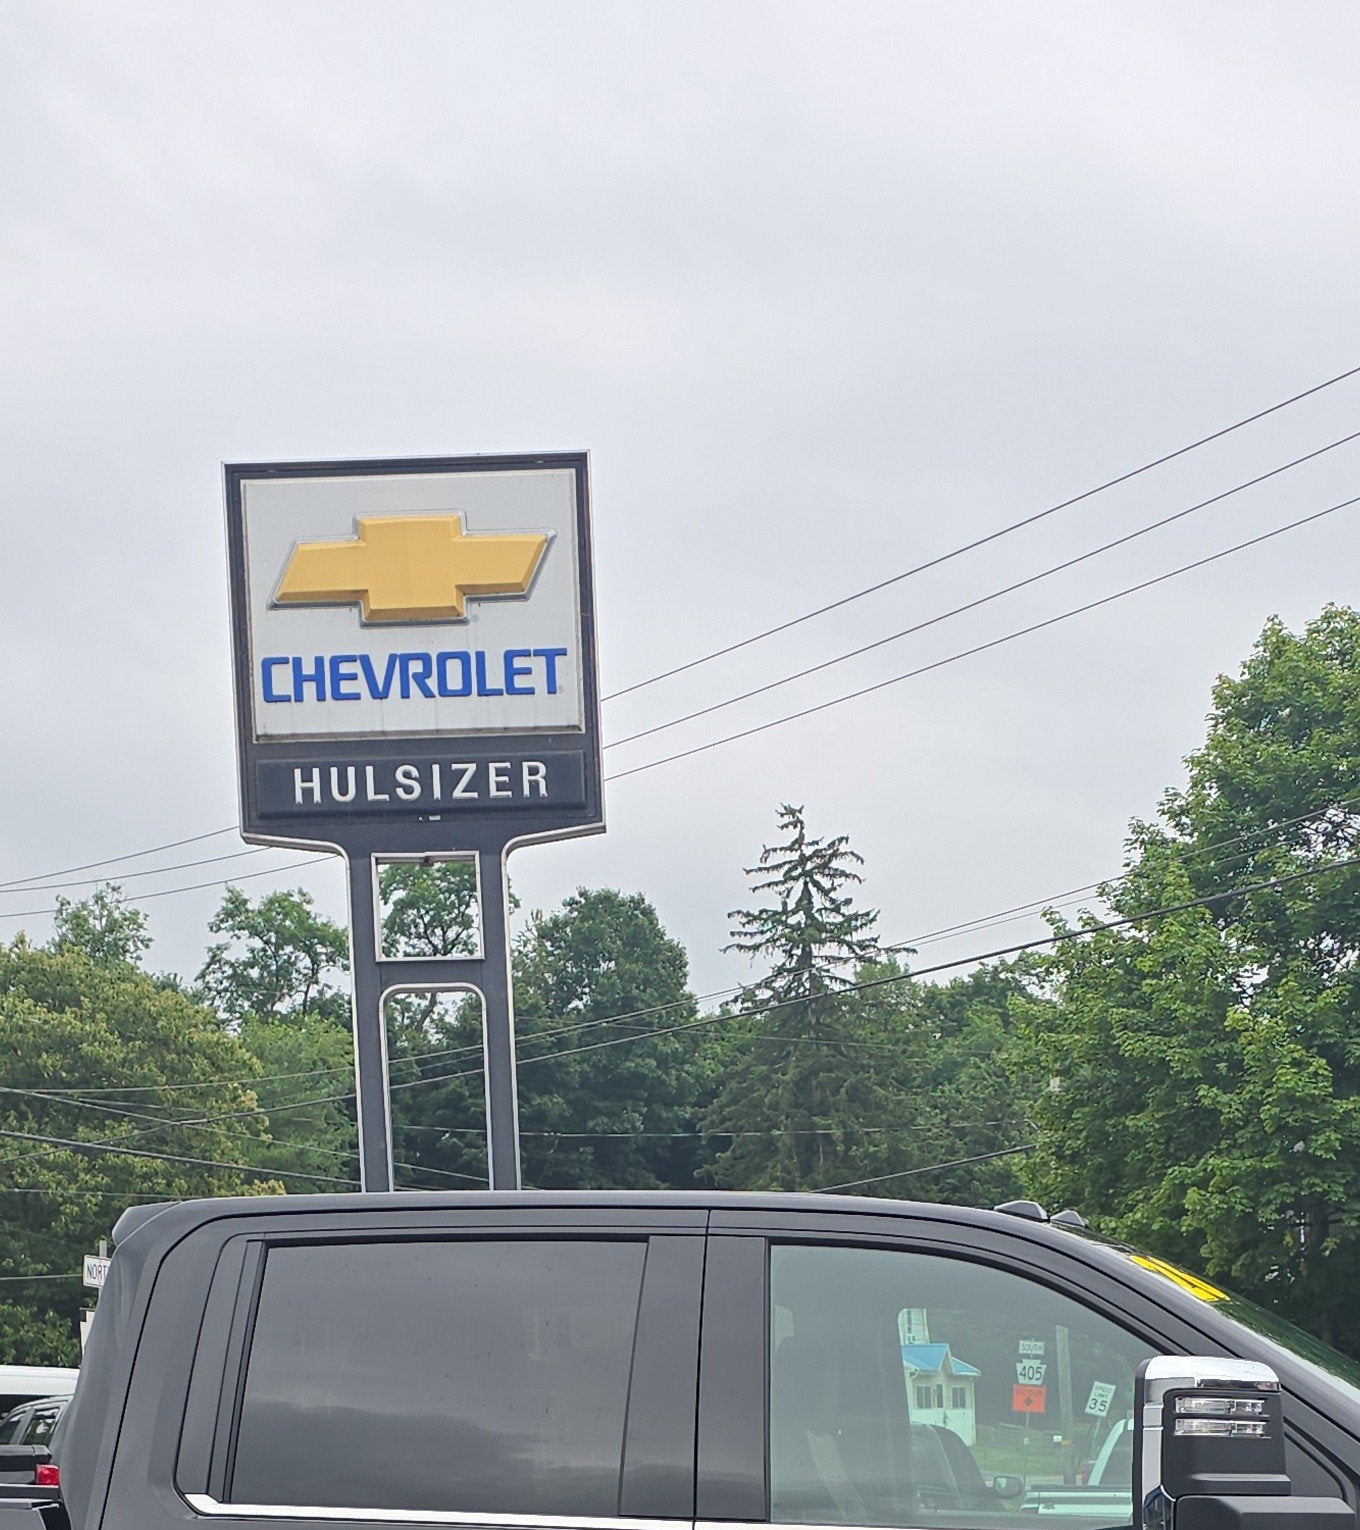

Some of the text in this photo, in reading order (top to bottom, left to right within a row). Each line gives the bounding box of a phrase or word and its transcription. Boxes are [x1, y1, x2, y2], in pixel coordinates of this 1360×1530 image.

[261, 647, 569, 703] CHEVROLET
[293, 761, 550, 804] HULSIZER
[86, 1263, 110, 1280] NORT
[1019, 1365, 1043, 1381] 405
[1089, 1398, 1107, 1412] 35
